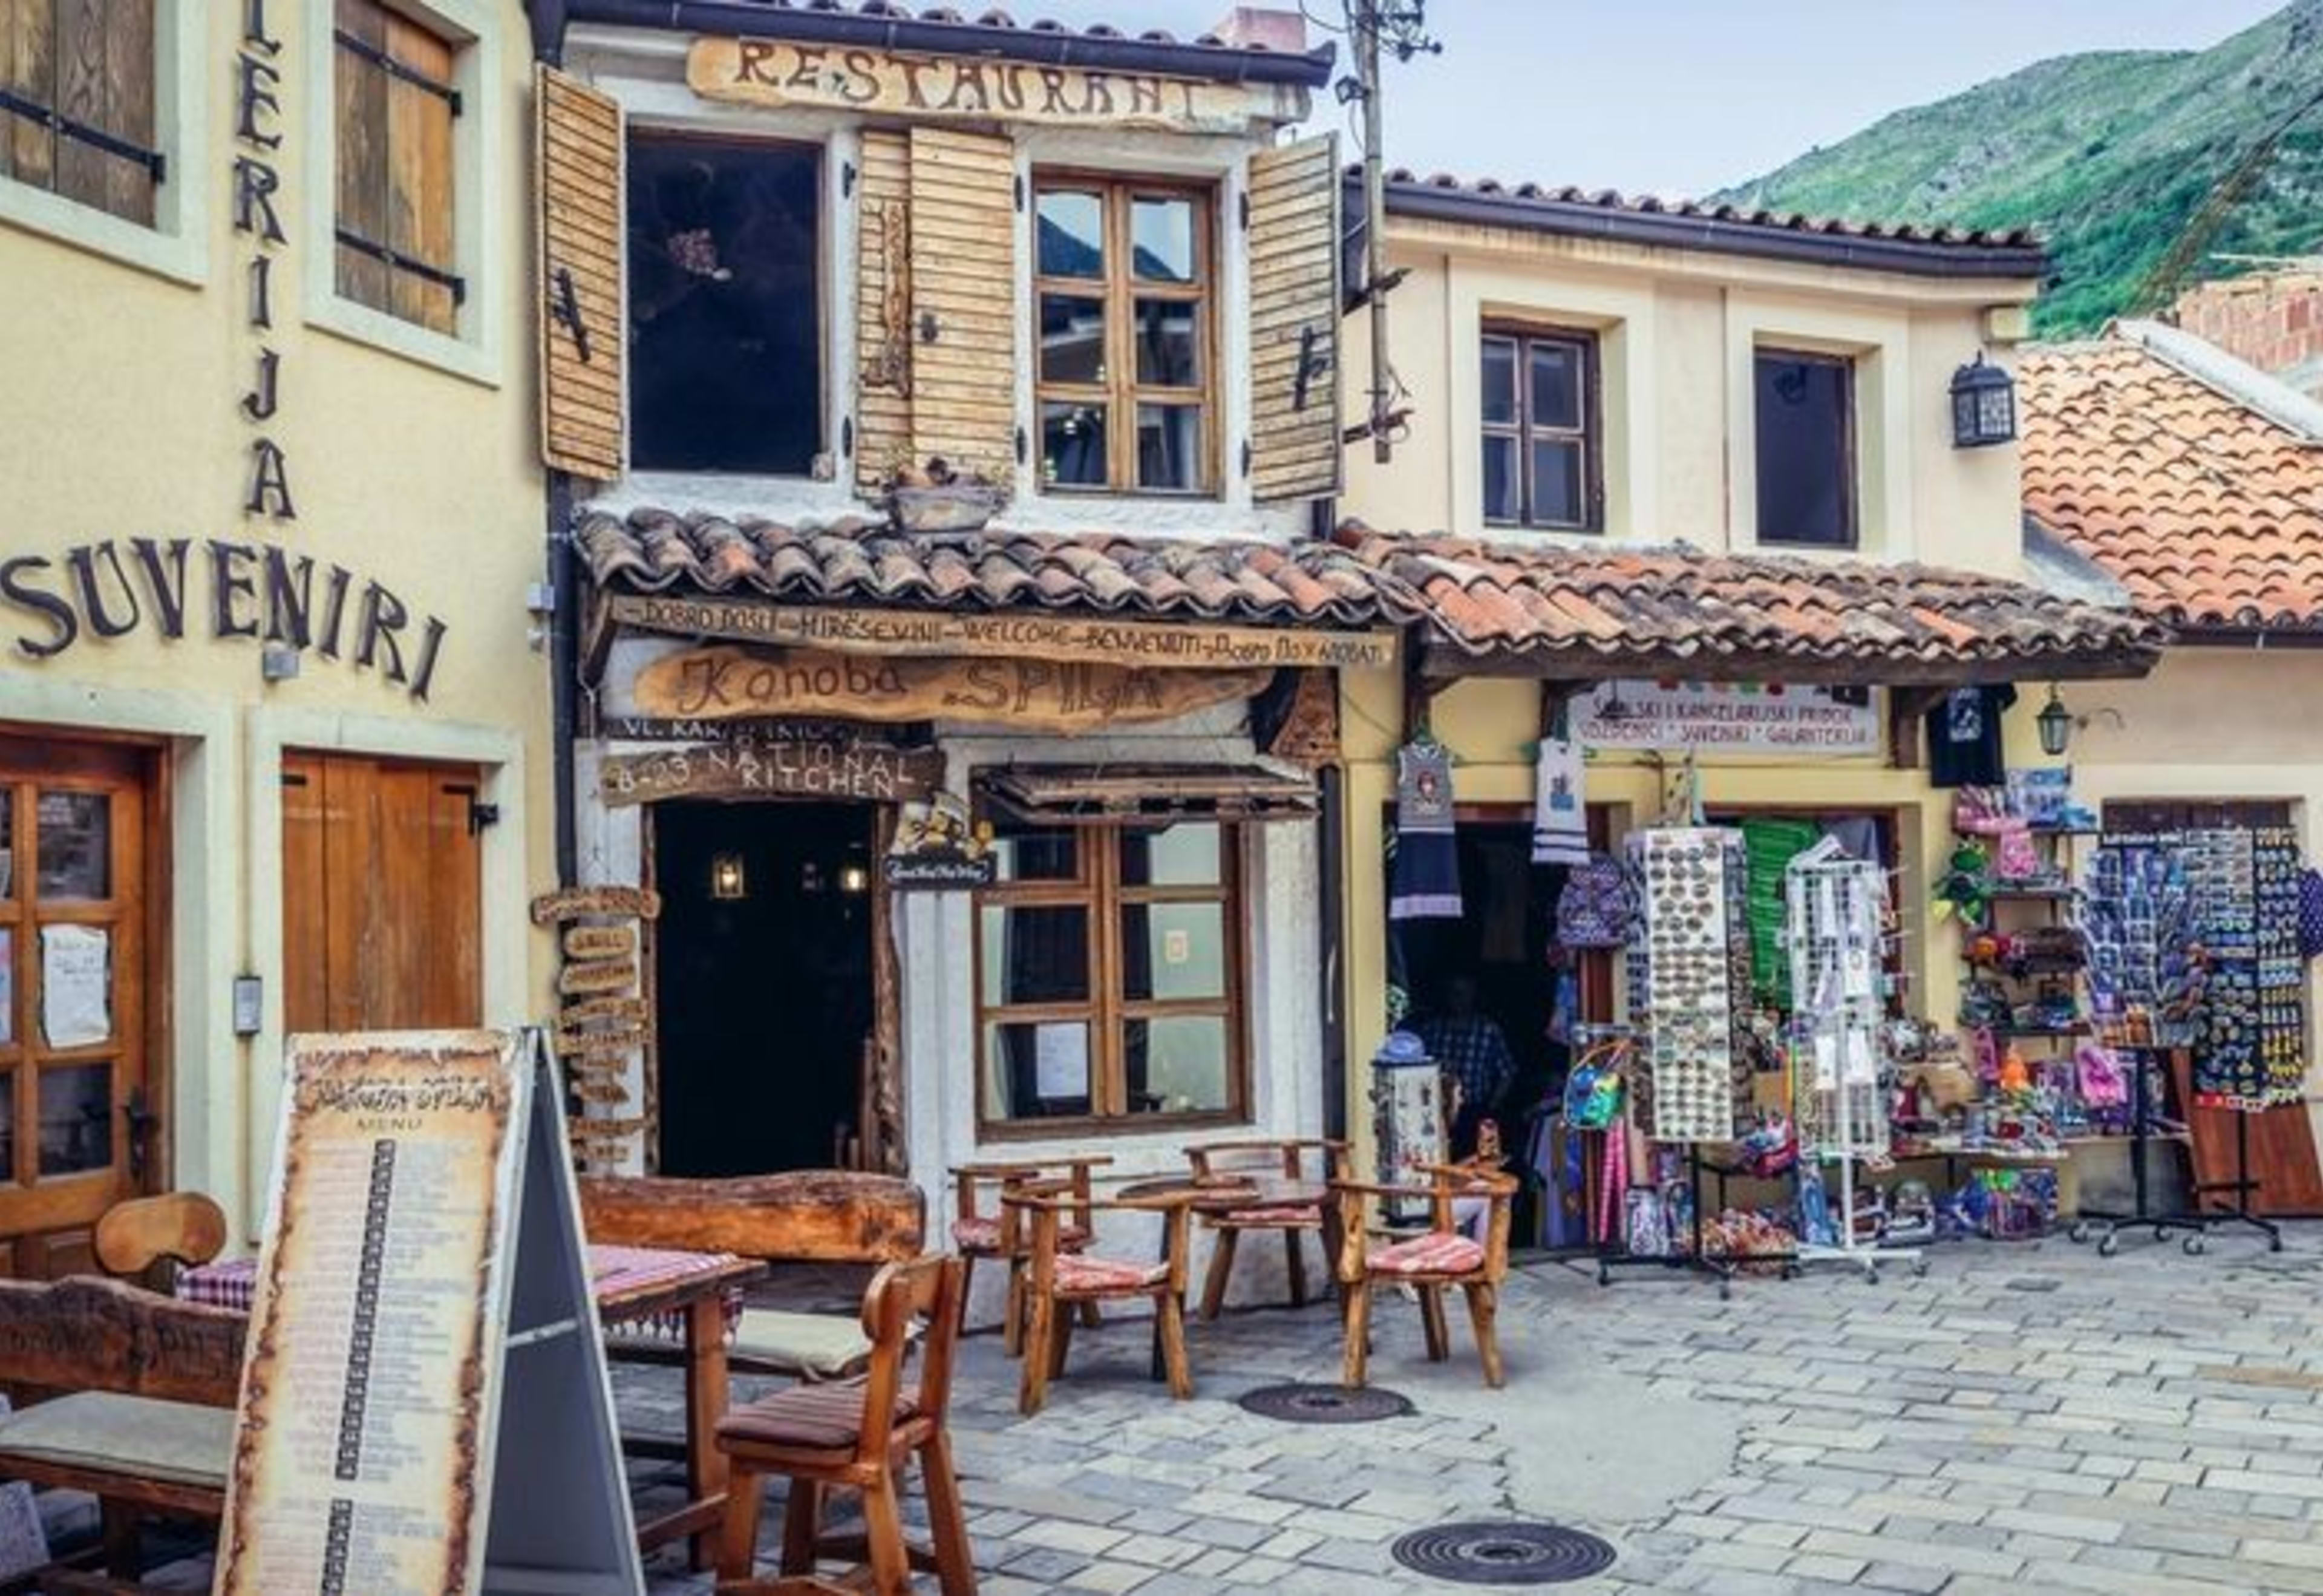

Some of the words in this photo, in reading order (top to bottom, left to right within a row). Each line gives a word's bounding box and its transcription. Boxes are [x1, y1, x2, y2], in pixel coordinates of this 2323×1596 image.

[0, 535, 448, 702] SUVENIRI
[677, 657, 907, 714] Konoba
[742, 767, 895, 798] KITCHEN
